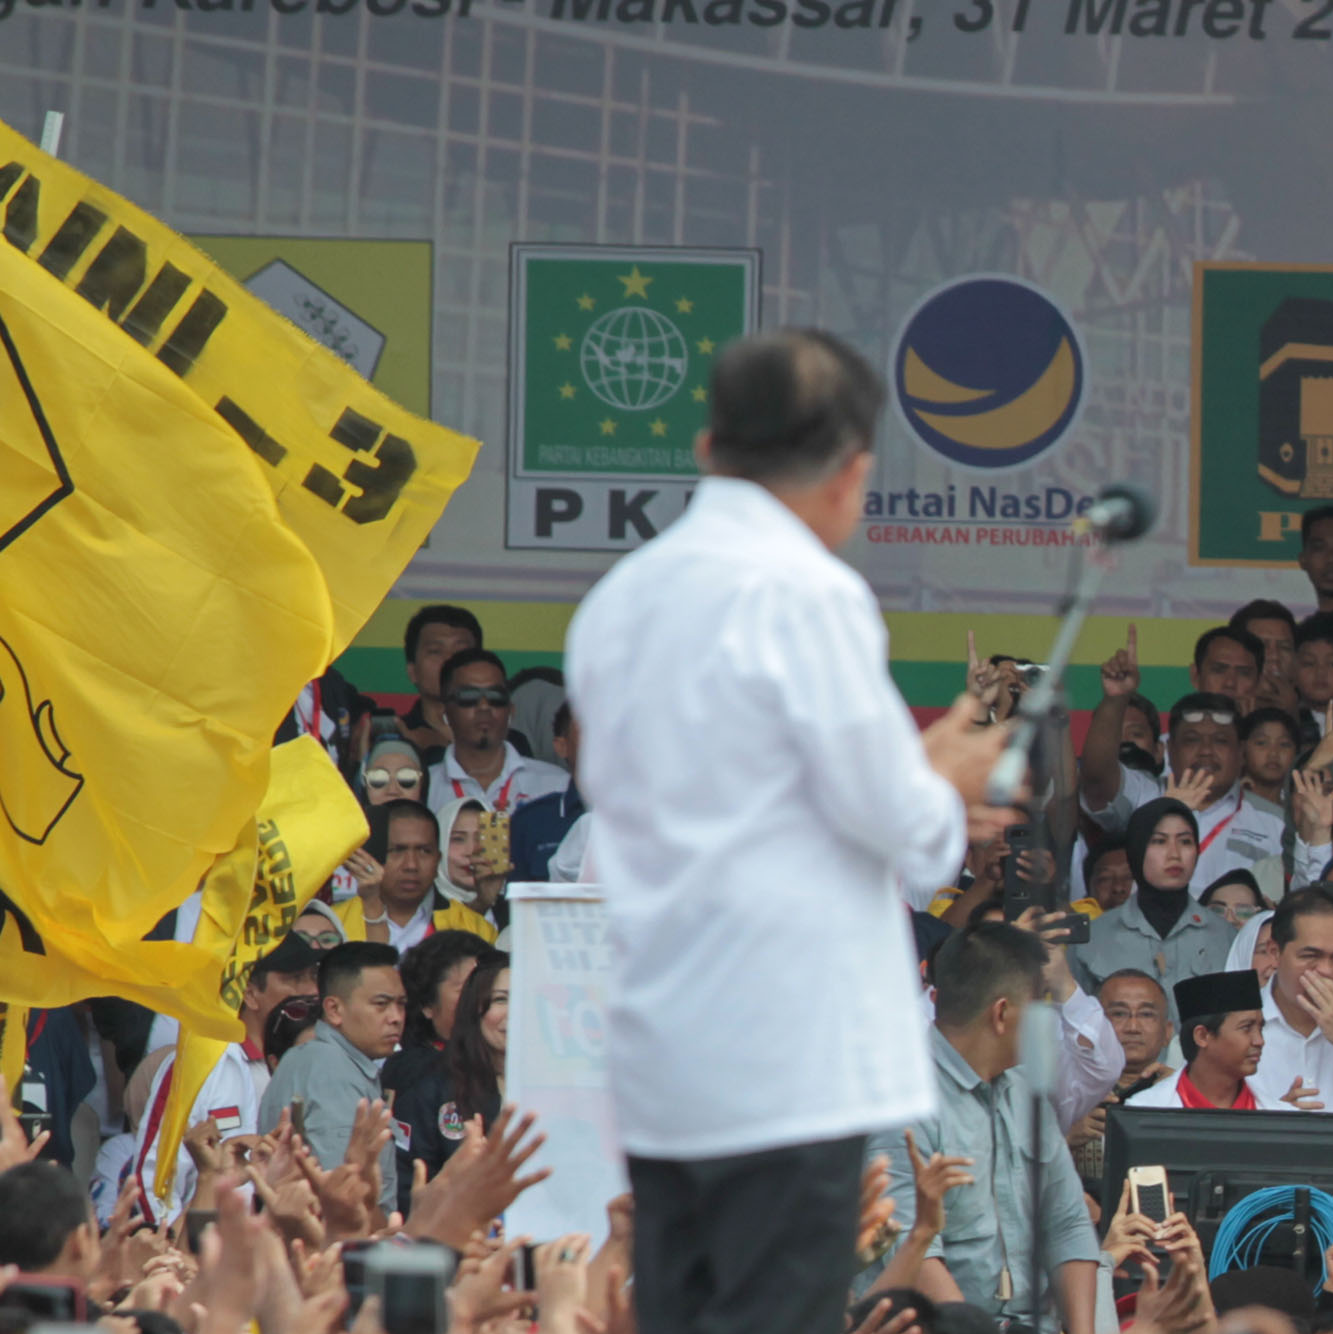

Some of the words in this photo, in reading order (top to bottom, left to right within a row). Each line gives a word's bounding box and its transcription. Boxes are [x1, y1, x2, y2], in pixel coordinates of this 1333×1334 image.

[1063, 0, 1272, 39] Maret
[534, 487, 695, 540] PK
[863, 486, 956, 517] artai
[969, 487, 1095, 520] NasDe
[867, 525, 970, 545] GERAKAN
